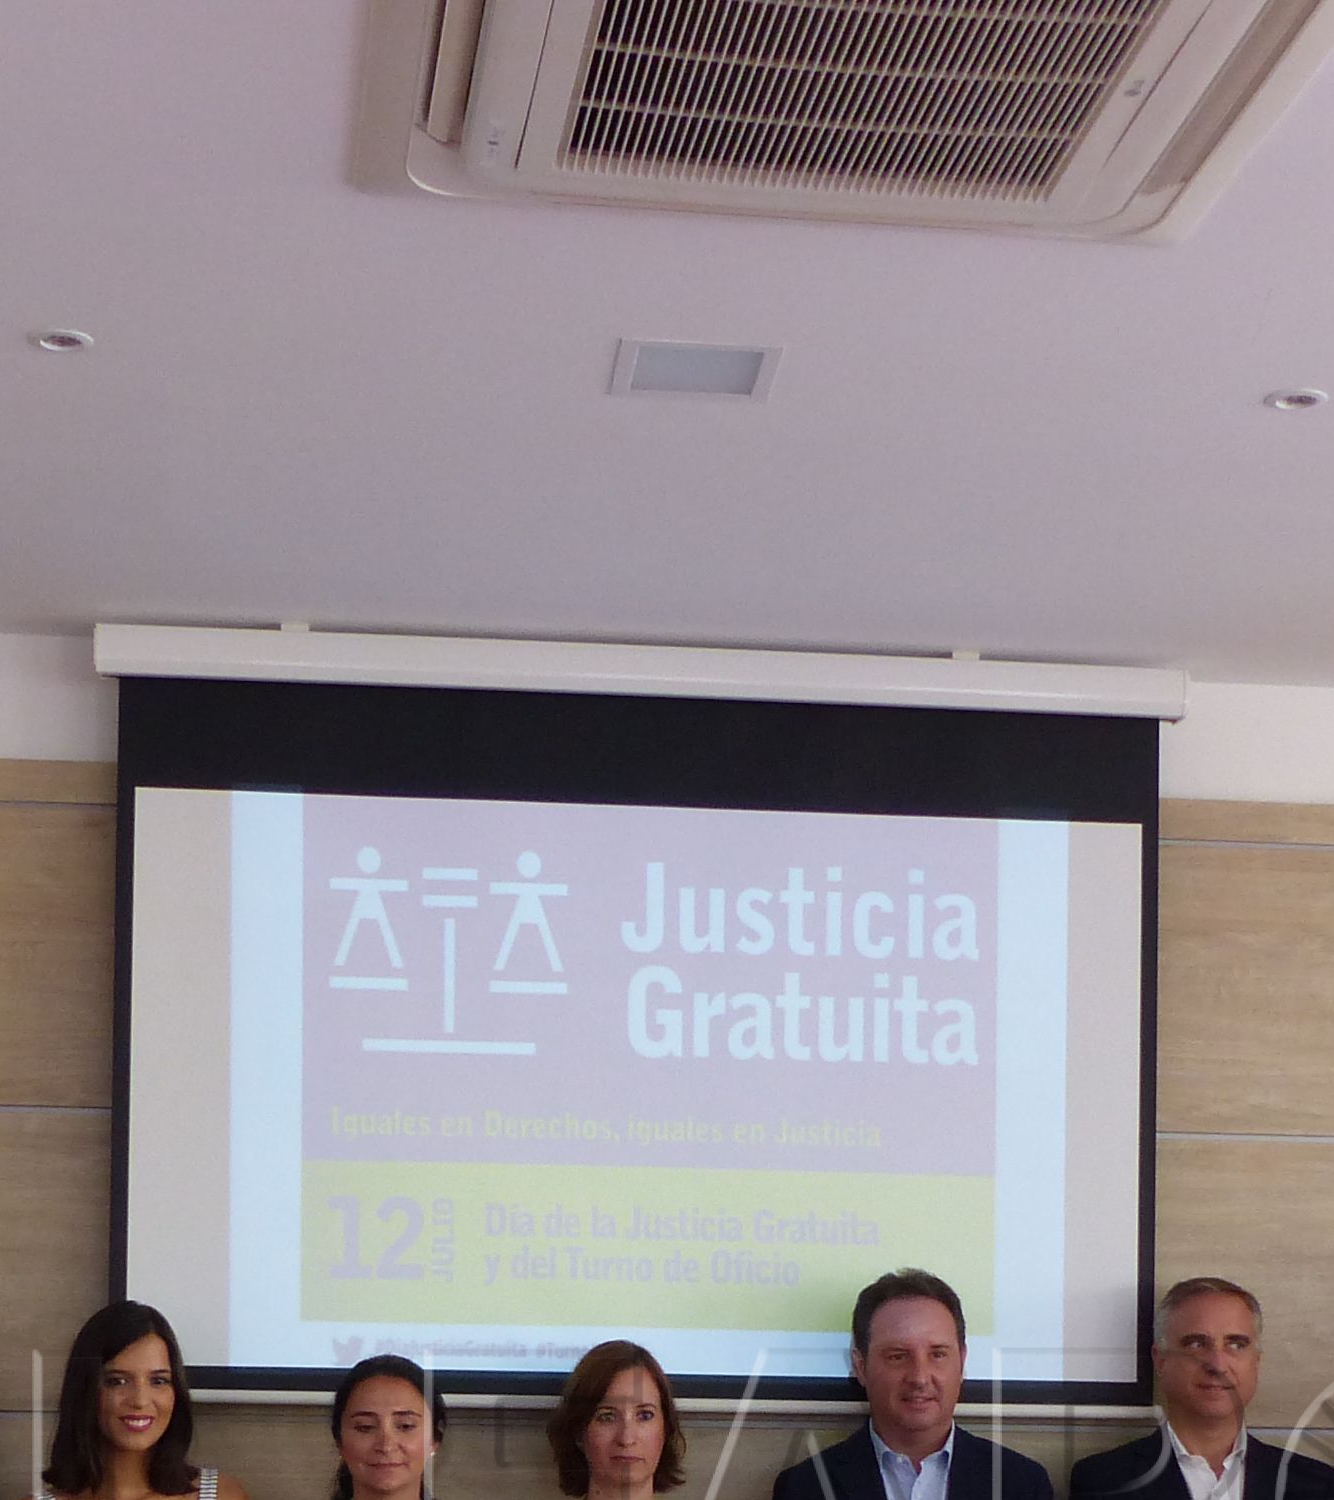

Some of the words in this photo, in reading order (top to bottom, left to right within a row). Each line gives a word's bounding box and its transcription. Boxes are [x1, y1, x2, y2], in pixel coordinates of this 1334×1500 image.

[620, 861, 980, 962] Justicia
[626, 965, 980, 1066] Gratuita
[329, 1106, 431, 1139] Iguales
[441, 1114, 474, 1138] en
[483, 1110, 621, 1144] Derechos,
[626, 1115, 724, 1147] iguales
[732, 1122, 766, 1146] en
[774, 1120, 882, 1149] Justicia
[327, 1194, 426, 1281] 12
[431, 1197, 455, 1283] JULIO
[484, 1254, 501, 1287] y
[511, 1246, 557, 1281] del
[563, 1249, 654, 1283] Turno
[663, 1250, 701, 1284] de
[710, 1251, 802, 1288] Oficio
[543, 1206, 582, 1240] de
[590, 1207, 618, 1240] la
[625, 1209, 744, 1244] Justicia
[753, 1209, 881, 1247] Gratuita
